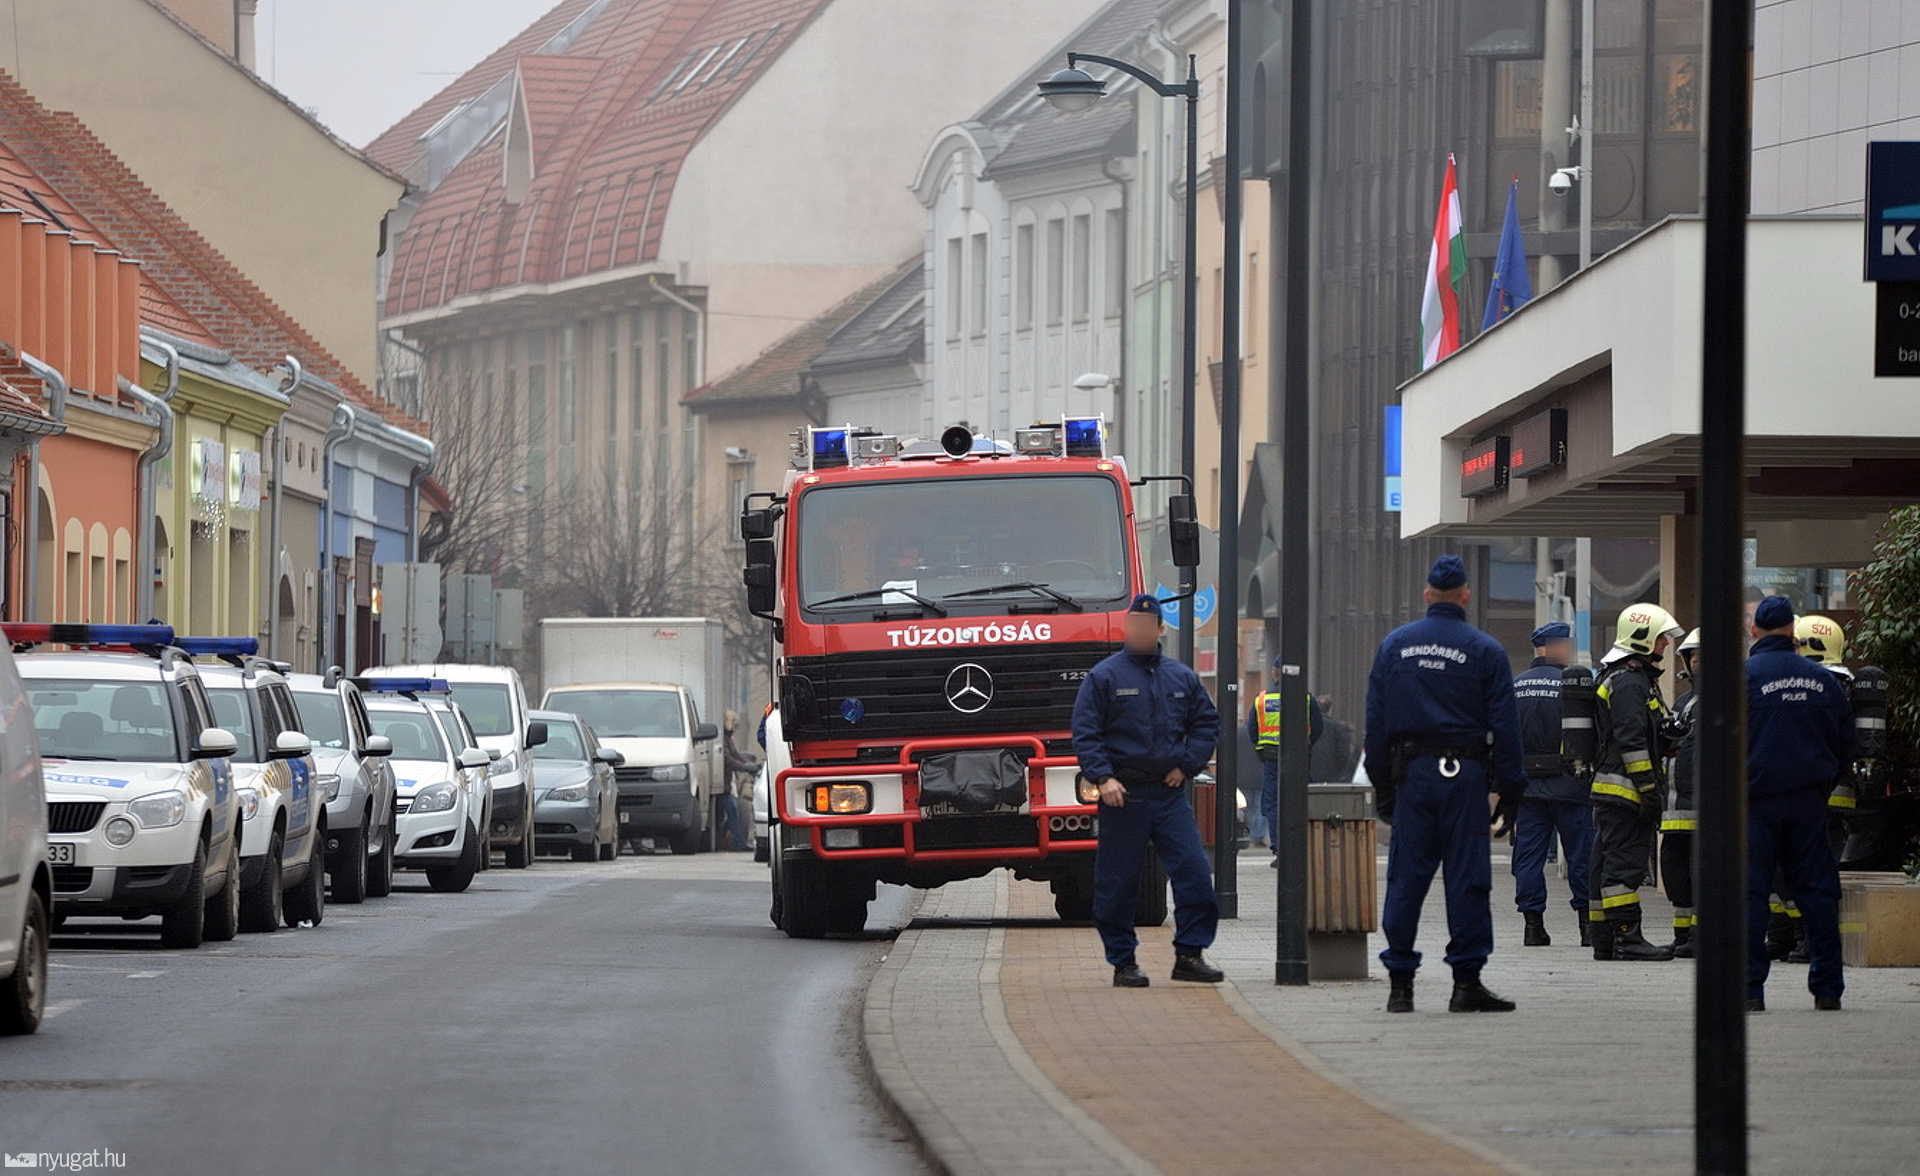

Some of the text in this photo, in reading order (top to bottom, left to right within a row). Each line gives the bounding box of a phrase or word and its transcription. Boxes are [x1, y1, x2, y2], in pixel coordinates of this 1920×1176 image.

[1899, 346, 1920, 362] ba
[1629, 612, 1651, 625] SZH
[887, 620, 1051, 647] TŰZOLTÓSÁG
[1812, 623, 1832, 636] SZH
[1418, 659, 1446, 670] POLICE
[1782, 691, 1807, 701] POLICE
